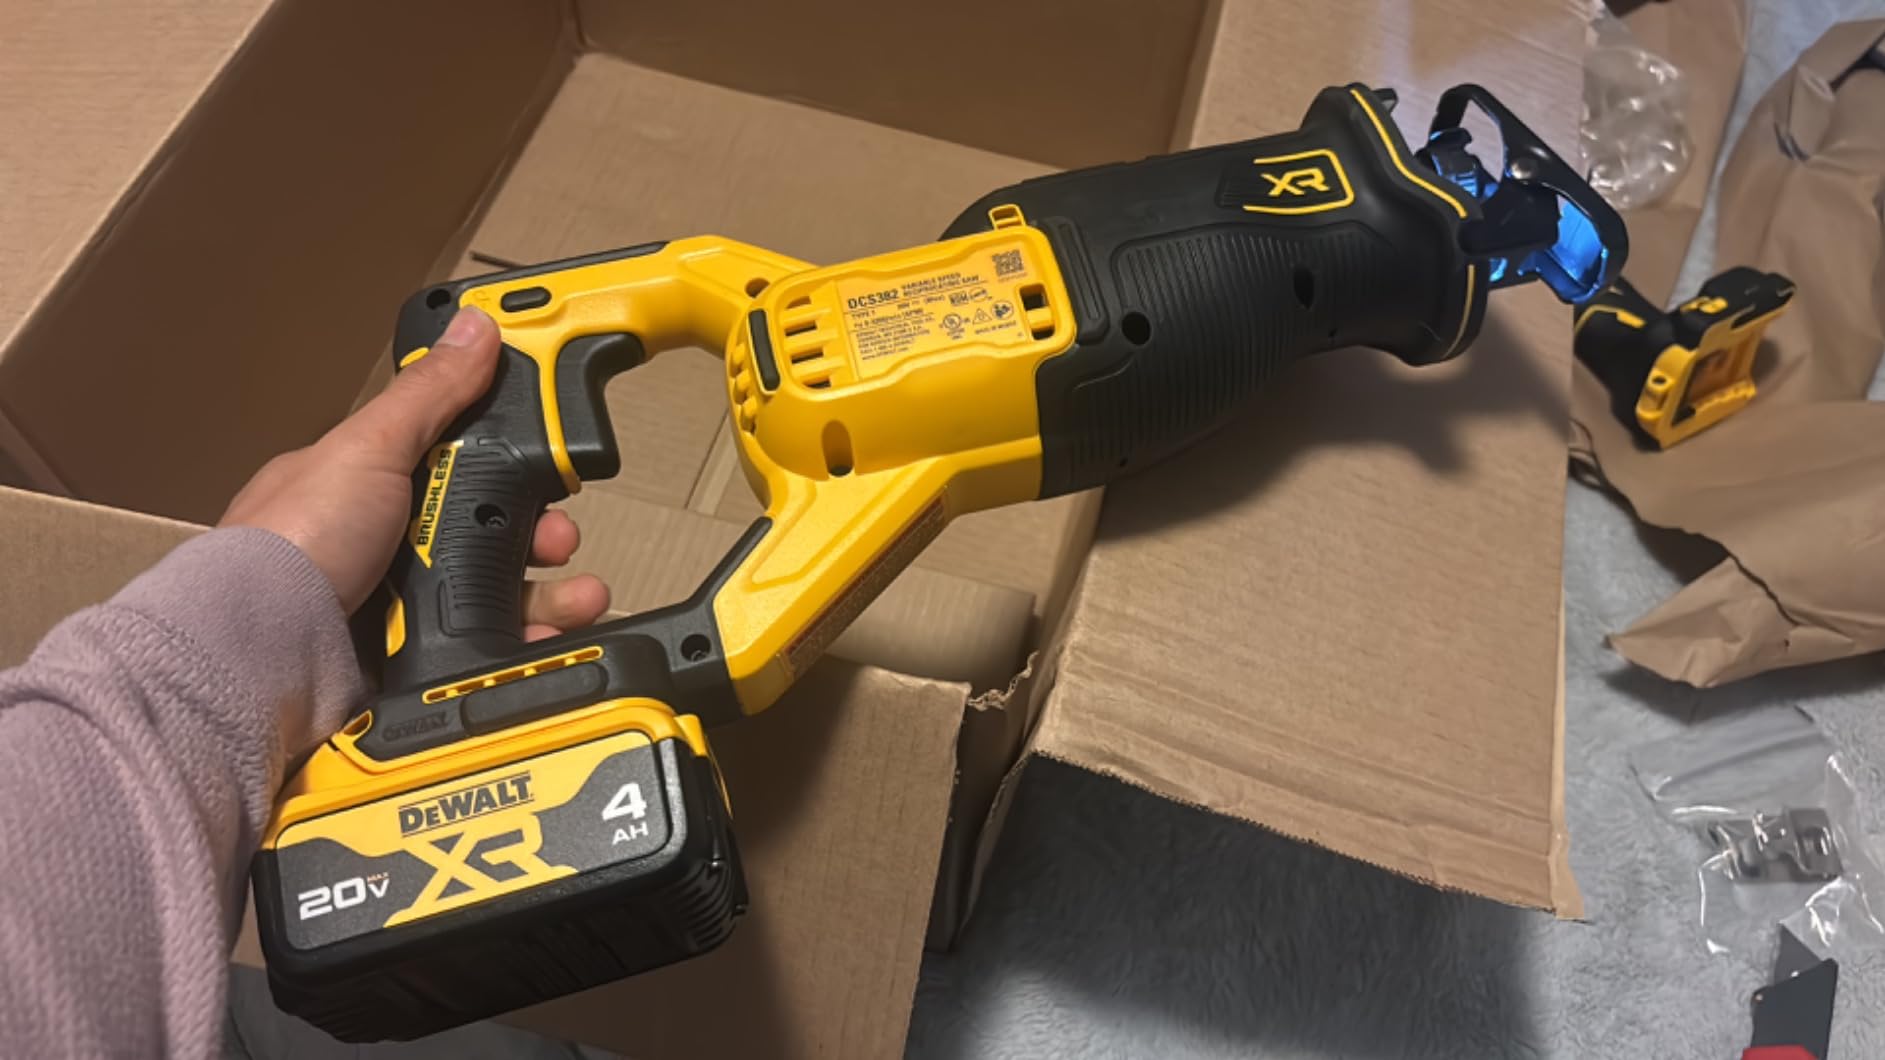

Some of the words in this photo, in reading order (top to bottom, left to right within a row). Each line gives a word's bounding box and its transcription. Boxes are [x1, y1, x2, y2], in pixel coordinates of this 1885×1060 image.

[1260, 167, 1331, 196] XR
[847, 288, 899, 309] DCS382
[416, 448, 453, 546] BRUSHLESS
[601, 782, 648, 821] 4
[612, 822, 649, 846] AH
[384, 814, 579, 928] XR
